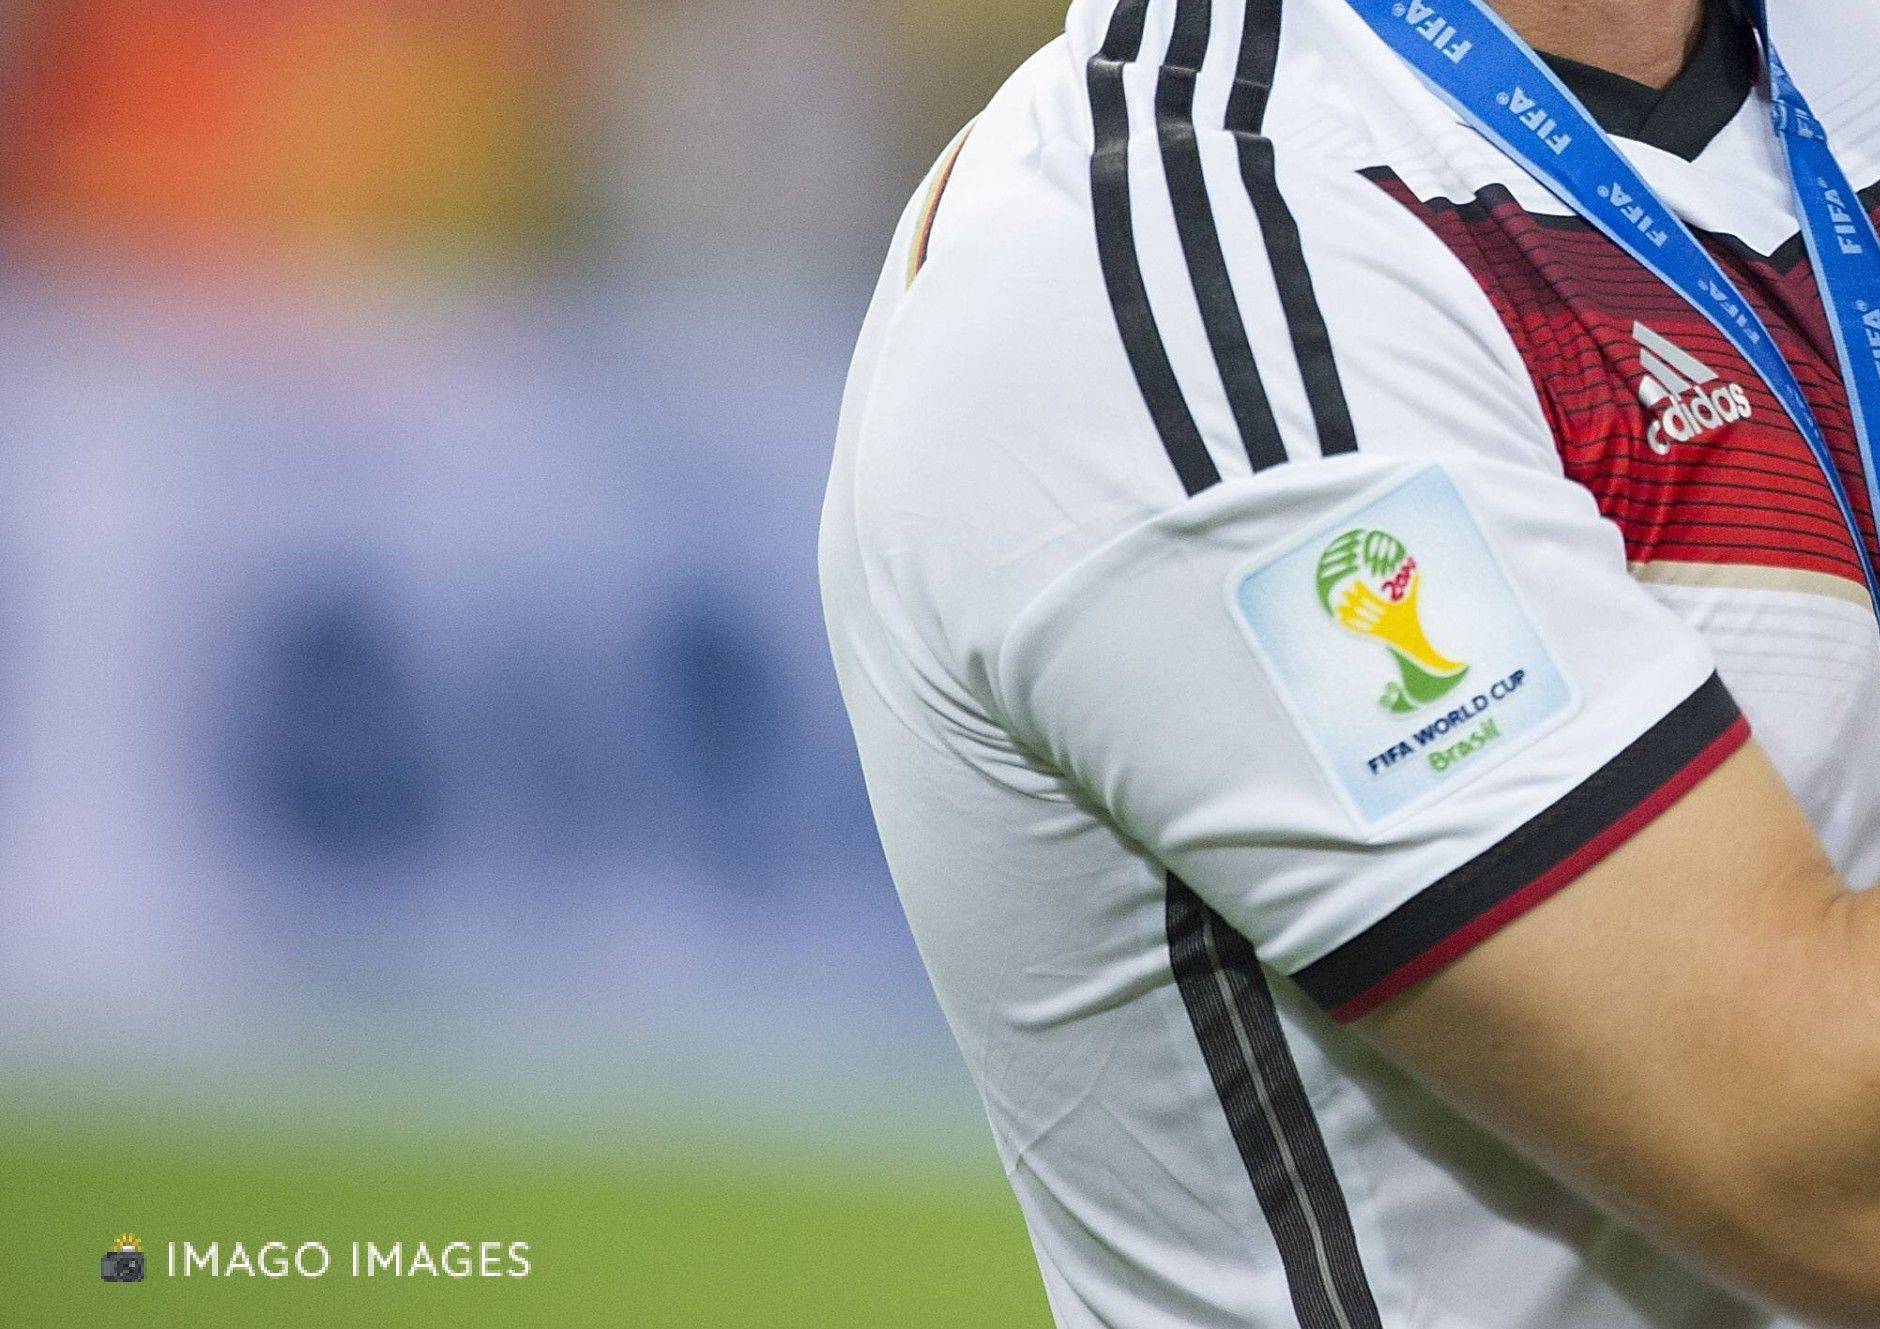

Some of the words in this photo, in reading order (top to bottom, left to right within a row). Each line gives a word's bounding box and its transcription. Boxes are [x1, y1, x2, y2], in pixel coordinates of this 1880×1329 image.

[1366, 742, 1415, 775] FIFA
[1413, 694, 1488, 748] WORLD
[1490, 669, 1527, 702] CUP
[1428, 719, 1500, 771] Brasil
